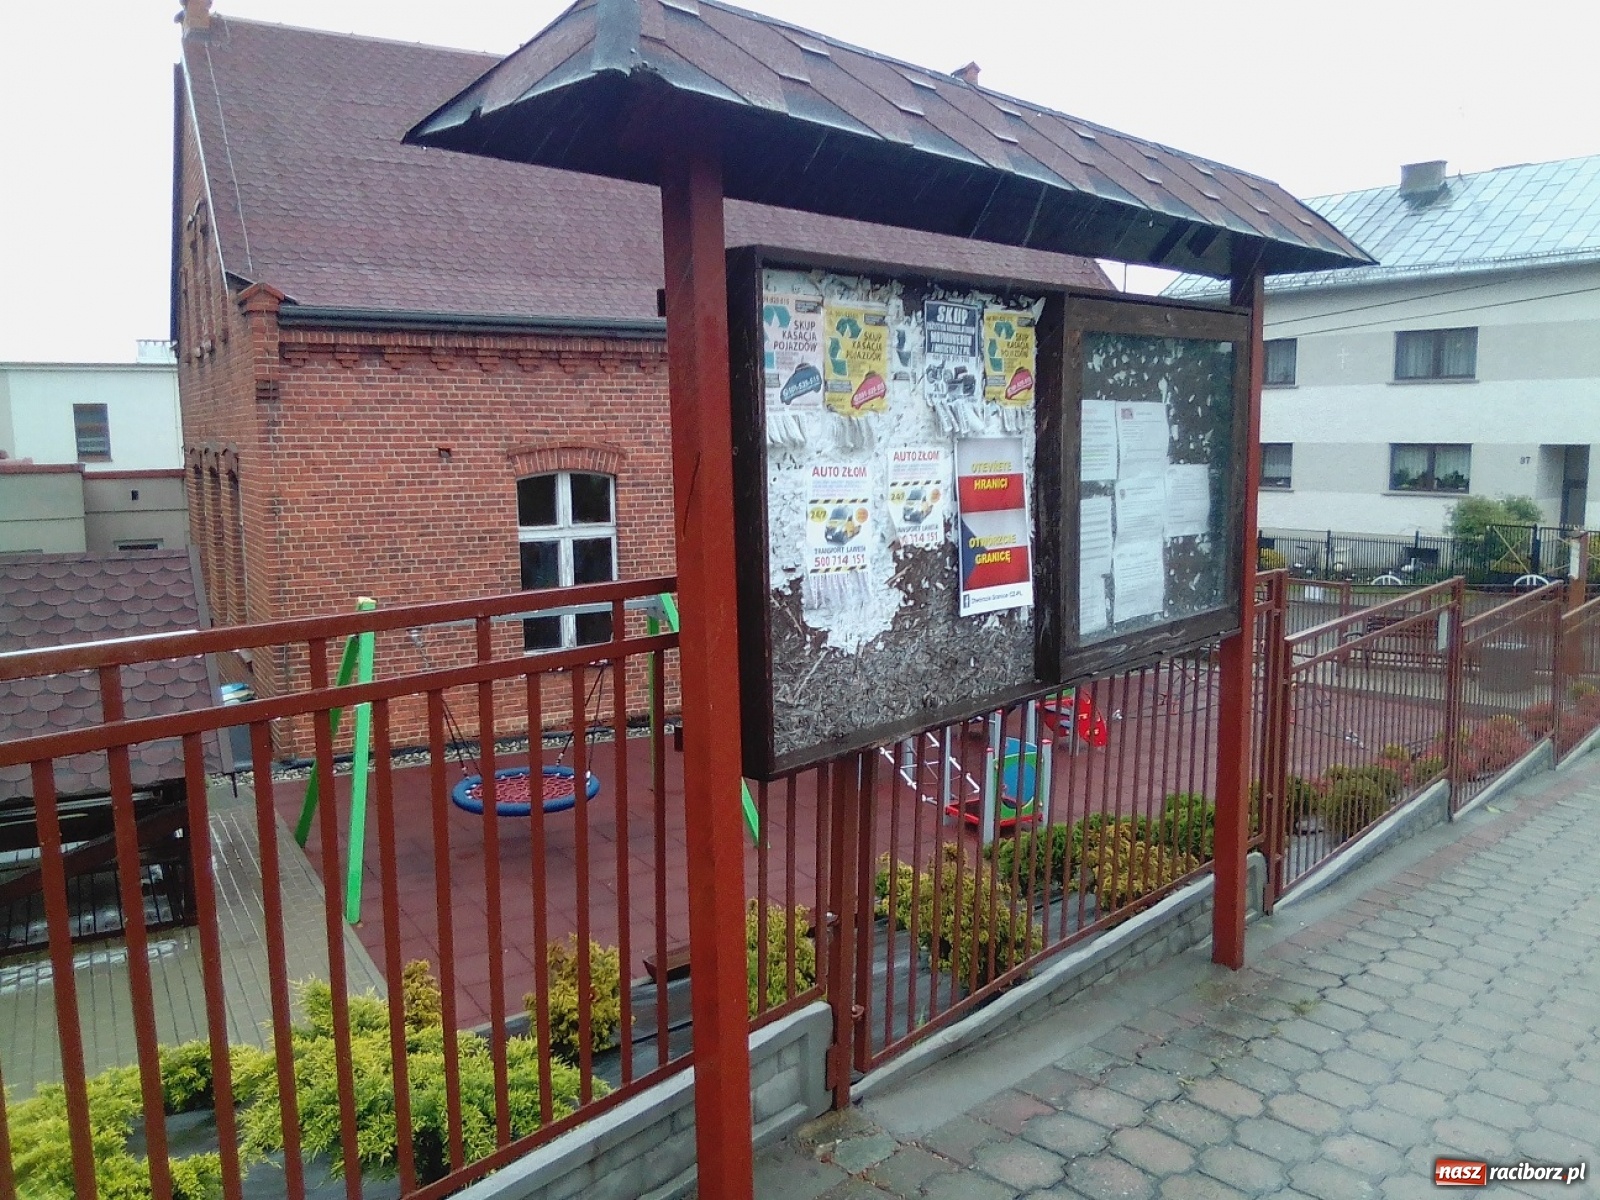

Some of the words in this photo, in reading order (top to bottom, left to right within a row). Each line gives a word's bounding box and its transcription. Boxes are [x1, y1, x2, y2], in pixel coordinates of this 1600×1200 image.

[937, 305, 969, 325] SKUP
[794, 320, 816, 333] SKUP
[782, 330, 817, 341] KASACJA
[864, 331, 882, 342] SKUP
[773, 340, 818, 353] POJAZDÓW
[893, 450, 916, 462] AUTO
[917, 450, 939, 461] ZŁOM
[812, 466, 839, 477] AUTO
[841, 466, 868, 477] ZŁOM
[973, 477, 1009, 491] HRANICI
[814, 556, 831, 567] 500
[832, 554, 849, 566] 714
[852, 553, 865, 564] 151
[974, 550, 1011, 564] GRANICĘ
